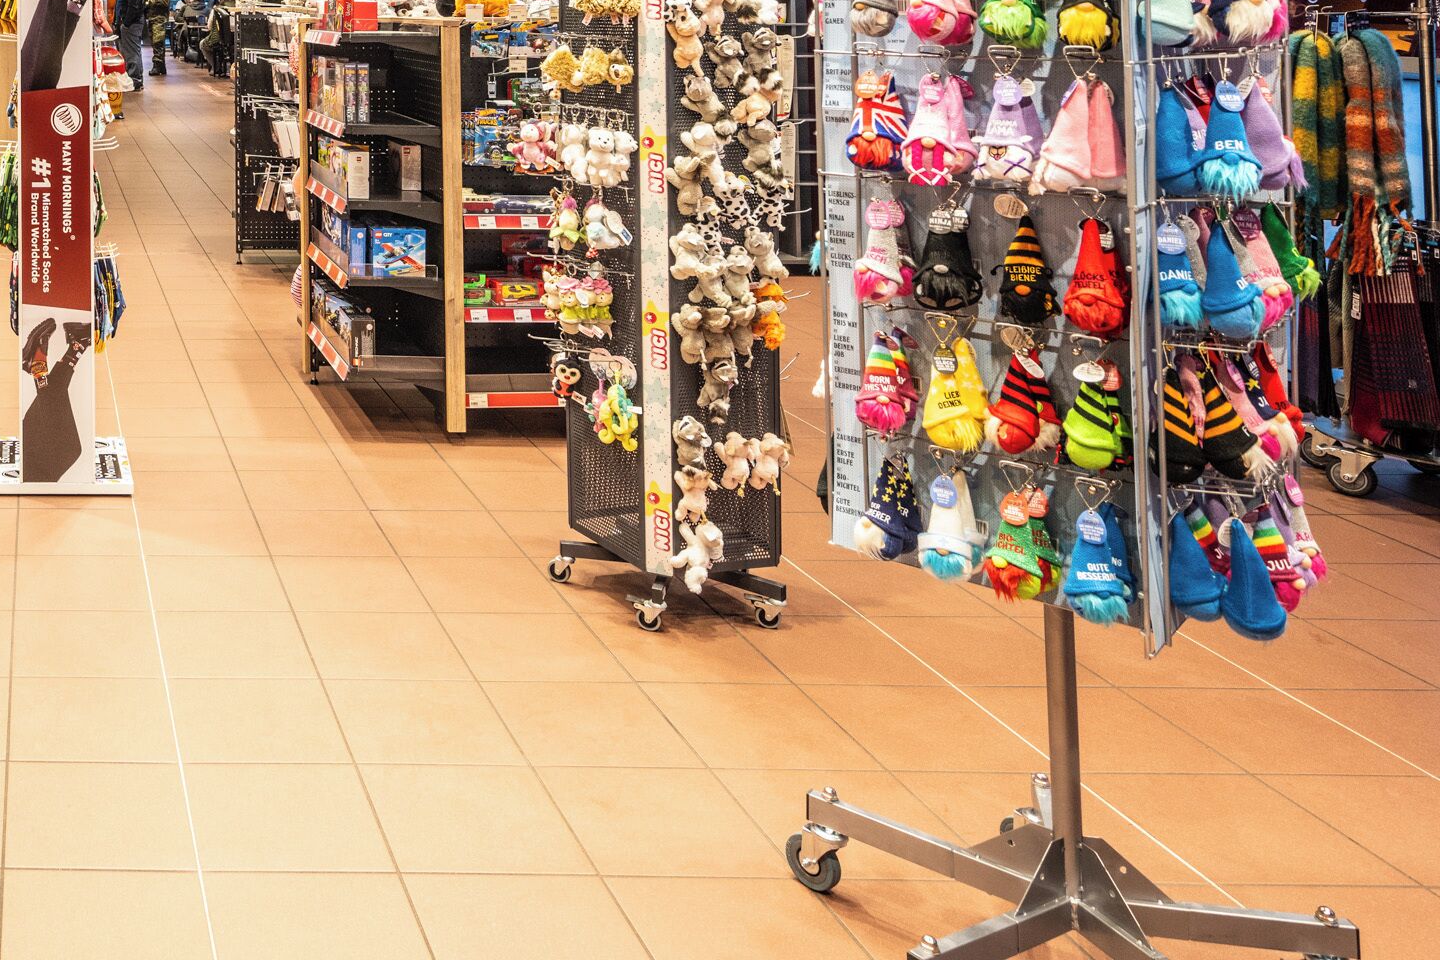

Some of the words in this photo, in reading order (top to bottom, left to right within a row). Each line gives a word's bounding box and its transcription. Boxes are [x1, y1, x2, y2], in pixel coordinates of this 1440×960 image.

[824, 0, 835, 9] FAN
[825, 17, 844, 25] GAMER
[825, 68, 839, 76] BRIT
[825, 115, 850, 124] EINHORN
[1215, 140, 1244, 150] BEN
[62, 140, 72, 174] MANY
[31, 157, 52, 188] #1
[649, 153, 668, 193] NICI
[62, 175, 72, 234] MORNINGS
[828, 197, 851, 207] MENSCH
[31, 193, 39, 225] Brand
[829, 213, 845, 221] NINJA
[42, 192, 52, 257] Mismatched
[929, 218, 951, 226] NINJA
[829, 236, 847, 245] BIENE
[1157, 236, 1183, 245] DANIEL
[31, 227, 39, 284] Worldwide
[830, 259, 853, 269] TEUFEL
[42, 259, 52, 293] Socks
[1010, 274, 1037, 282] BIENE
[1159, 269, 1193, 281] DANIE
[832, 310, 848, 318] BORN
[833, 318, 846, 326] THIS
[833, 334, 850, 343] LIEBE
[651, 329, 671, 369] NICI
[833, 342, 854, 351] DEINEN
[834, 350, 845, 358] JOB
[869, 375, 890, 383] BORN
[864, 383, 880, 391] THIS
[881, 384, 897, 393] WAY
[944, 391, 960, 399] LIEB
[837, 449, 855, 458] ERSTE
[837, 456, 854, 466] HILFE
[837, 480, 861, 492] WICHTEL
[836, 497, 851, 506] GUTE
[654, 510, 671, 552] NICI
[1087, 563, 1109, 571] GUTE
